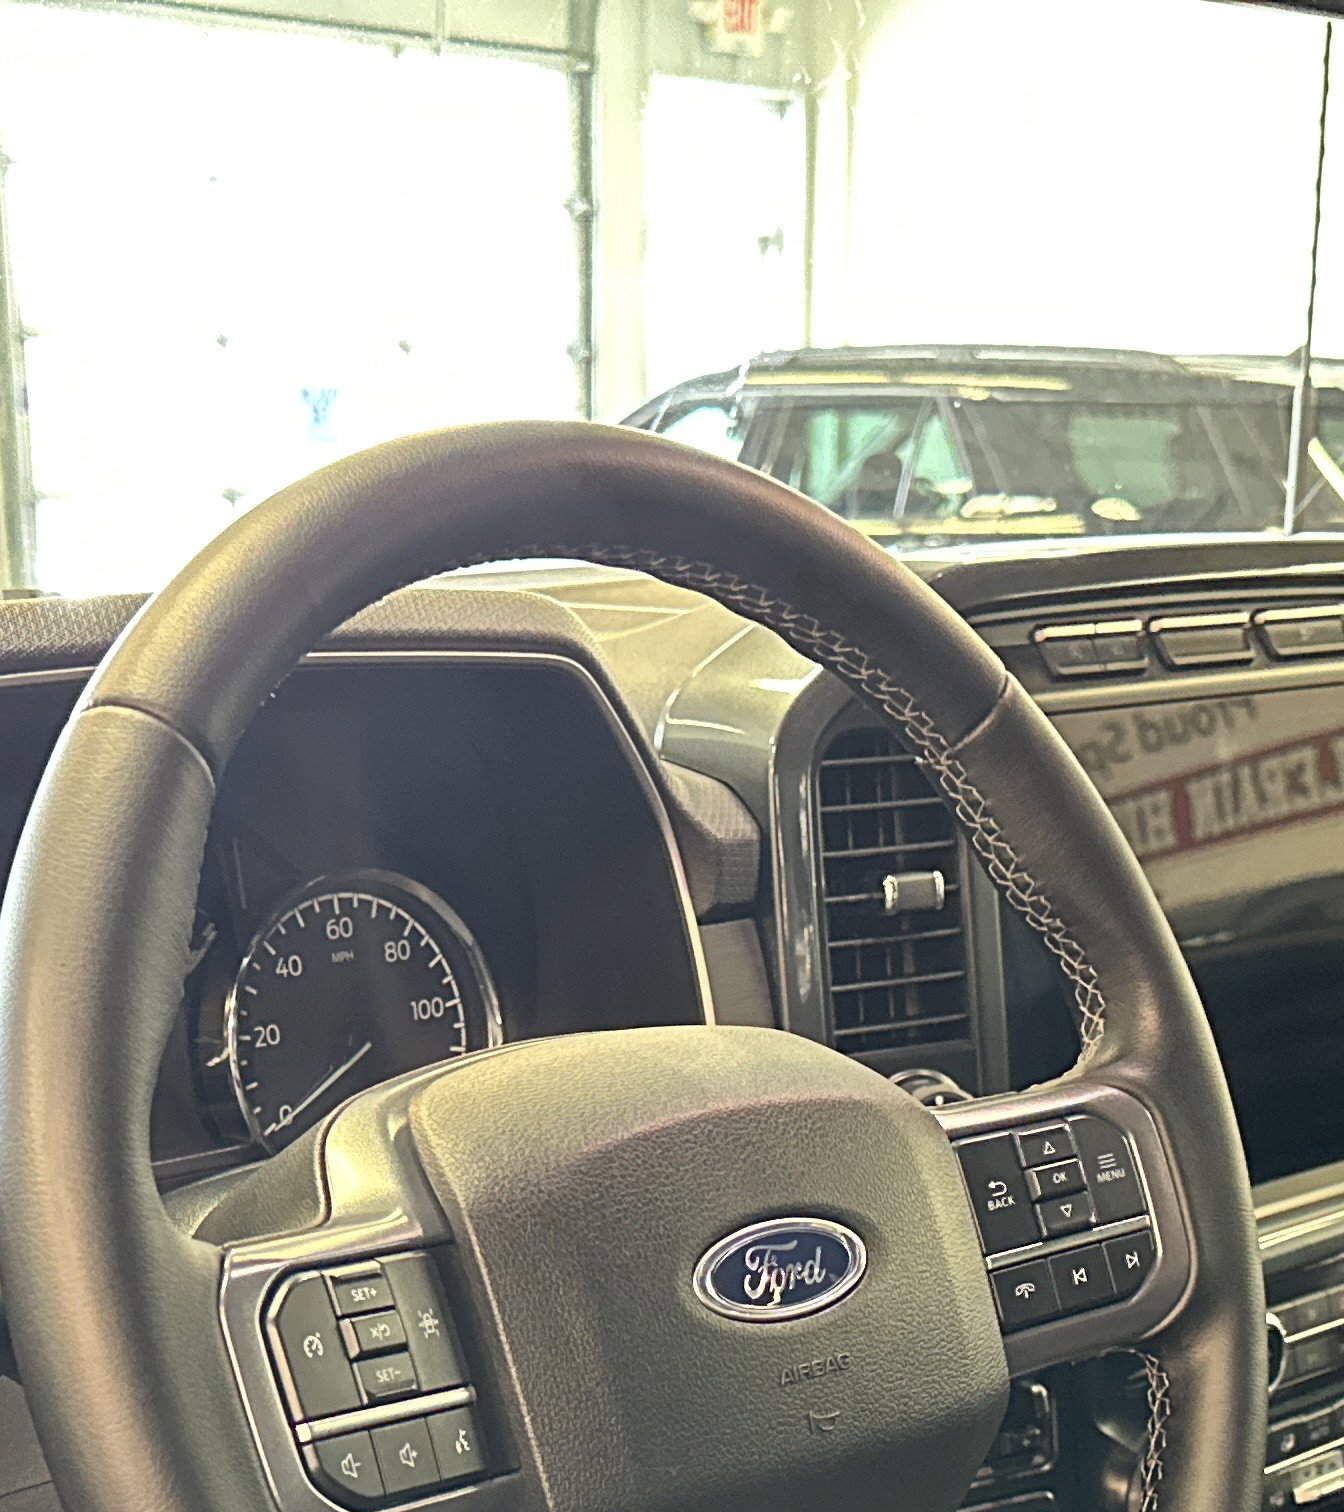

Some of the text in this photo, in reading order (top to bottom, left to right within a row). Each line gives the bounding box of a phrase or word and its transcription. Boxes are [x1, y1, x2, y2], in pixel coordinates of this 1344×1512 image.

[326, 917, 353, 940] 60
[331, 950, 354, 963] MPH
[384, 940, 411, 963] 80
[275, 955, 302, 978] 40
[410, 997, 444, 1021] 100
[254, 1024, 280, 1048] 20
[279, 1105, 293, 1126] 0
[1052, 1171, 1068, 1184] OK
[1096, 1168, 1126, 1184] MENU
[987, 1196, 1016, 1211] BACK
[744, 1240, 826, 1301] Ford
[780, 1352, 856, 1386] AIRBAG
